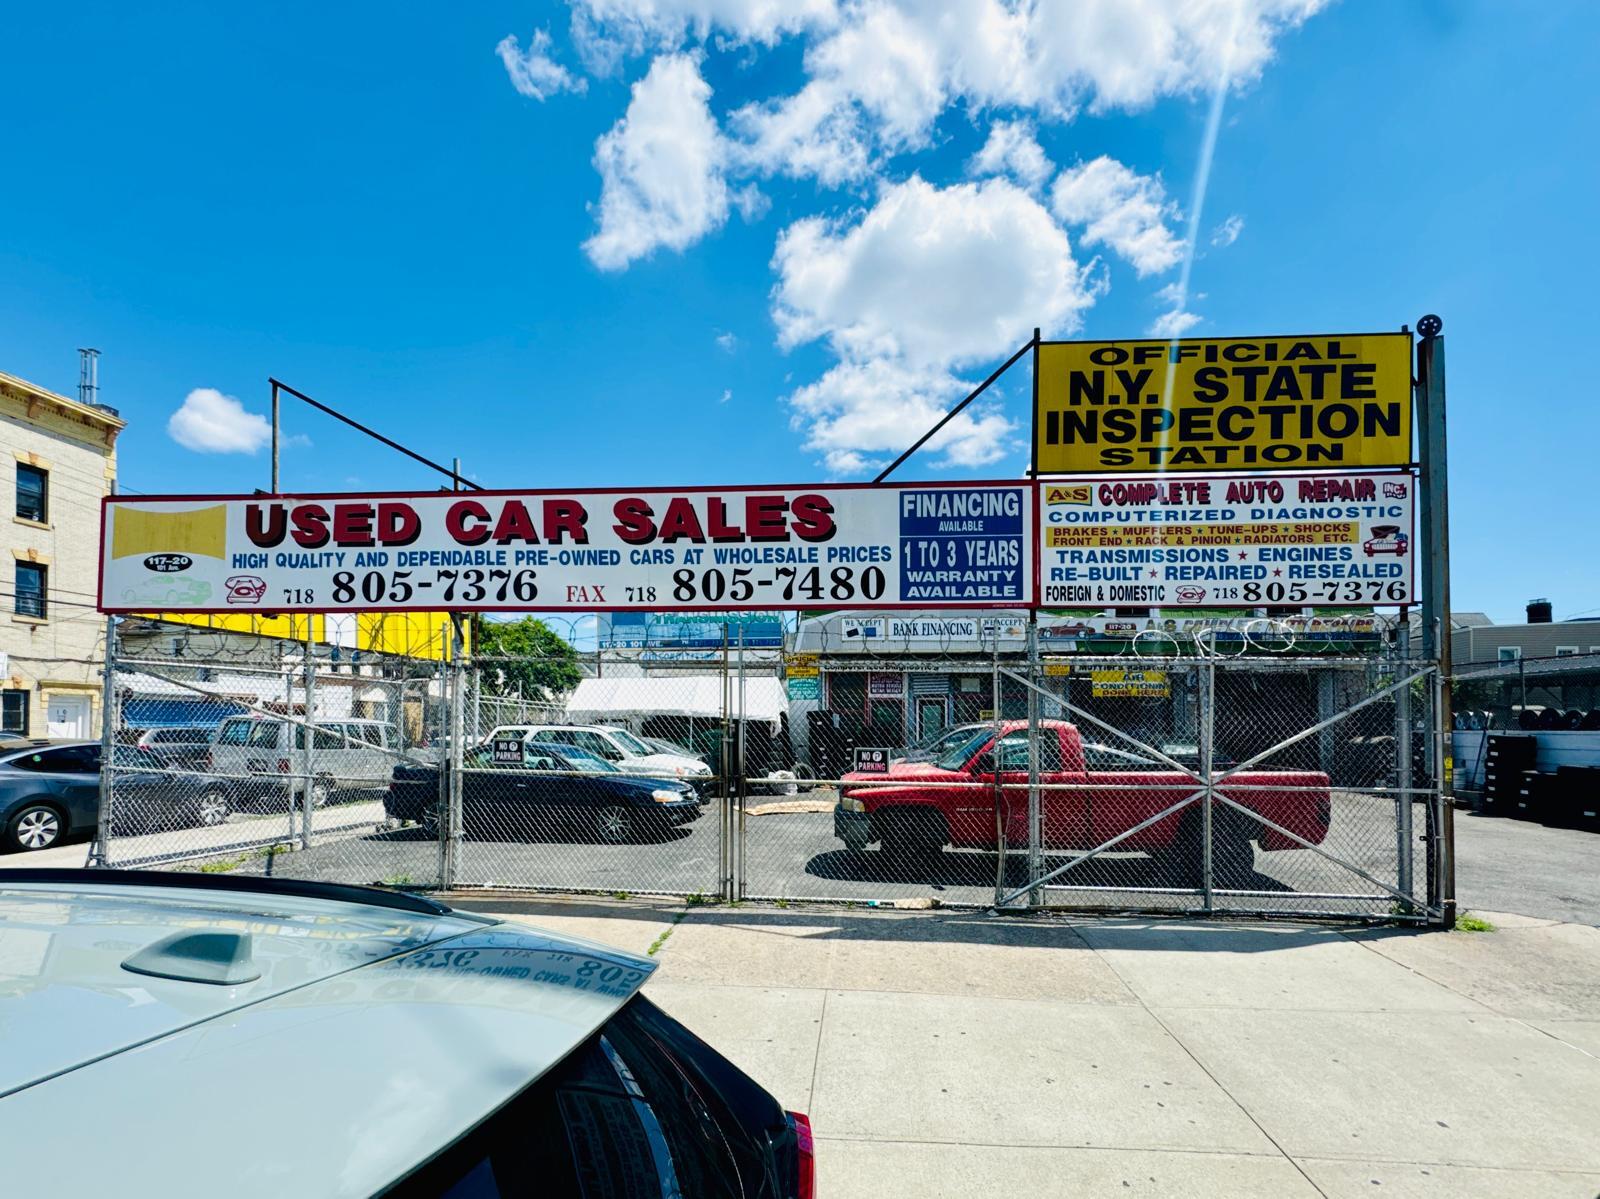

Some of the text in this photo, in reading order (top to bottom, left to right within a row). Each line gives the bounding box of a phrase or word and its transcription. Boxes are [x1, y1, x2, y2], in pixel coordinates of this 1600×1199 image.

[1089, 342, 1357, 366] OFFICIAL
[1069, 364, 1377, 406] N.Y. STATE
[1046, 402, 1401, 445] INSPECTION
[1099, 443, 1343, 466] STATION
[1047, 488, 1089, 502] A&S
[1098, 482, 1211, 507] COMPLETE
[1225, 480, 1284, 505] AUTO
[1298, 479, 1376, 504] REPAIR
[903, 492, 1019, 518] FINANCING
[245, 494, 837, 548] USED CAR SALES
[1048, 506, 1403, 523] COMPUTERIZED DIAGNOSTIC
[938, 520, 984, 532] AVAILABLE
[1053, 523, 1351, 536] BRAKES MUFFLERS TUNE-UPS SHOCKS
[1053, 533, 1352, 546] FRONT END RACK & PINION RADIATORS ETC.
[148, 557, 189, 565] 117-20
[232, 546, 892, 569] HIGH QUALITY AND DEPENDABLE PRE-OWNED CARS AT WHOLESALE PRICES
[904, 539, 1019, 569] 1 TO 3 YEARS
[1056, 546, 1353, 564] TRANSMISSIONS ENGINES
[906, 570, 1016, 583] WARRANTY
[1050, 563, 1403, 582] RE-BUILT REPAIRED RESEALED
[283, 566, 886, 604] 718 805-7376 FAX 718 805-7480
[906, 585, 1017, 598] AVAILABLE
[1045, 581, 1407, 602] FOREIGN & DOMESTIC 718 805-7376
[893, 622, 973, 636] BANK FINANCING
[498, 742, 508, 750] NO
[496, 752, 521, 760] PARKING
[861, 751, 871, 761] NO
[858, 762, 886, 771] PARKING
